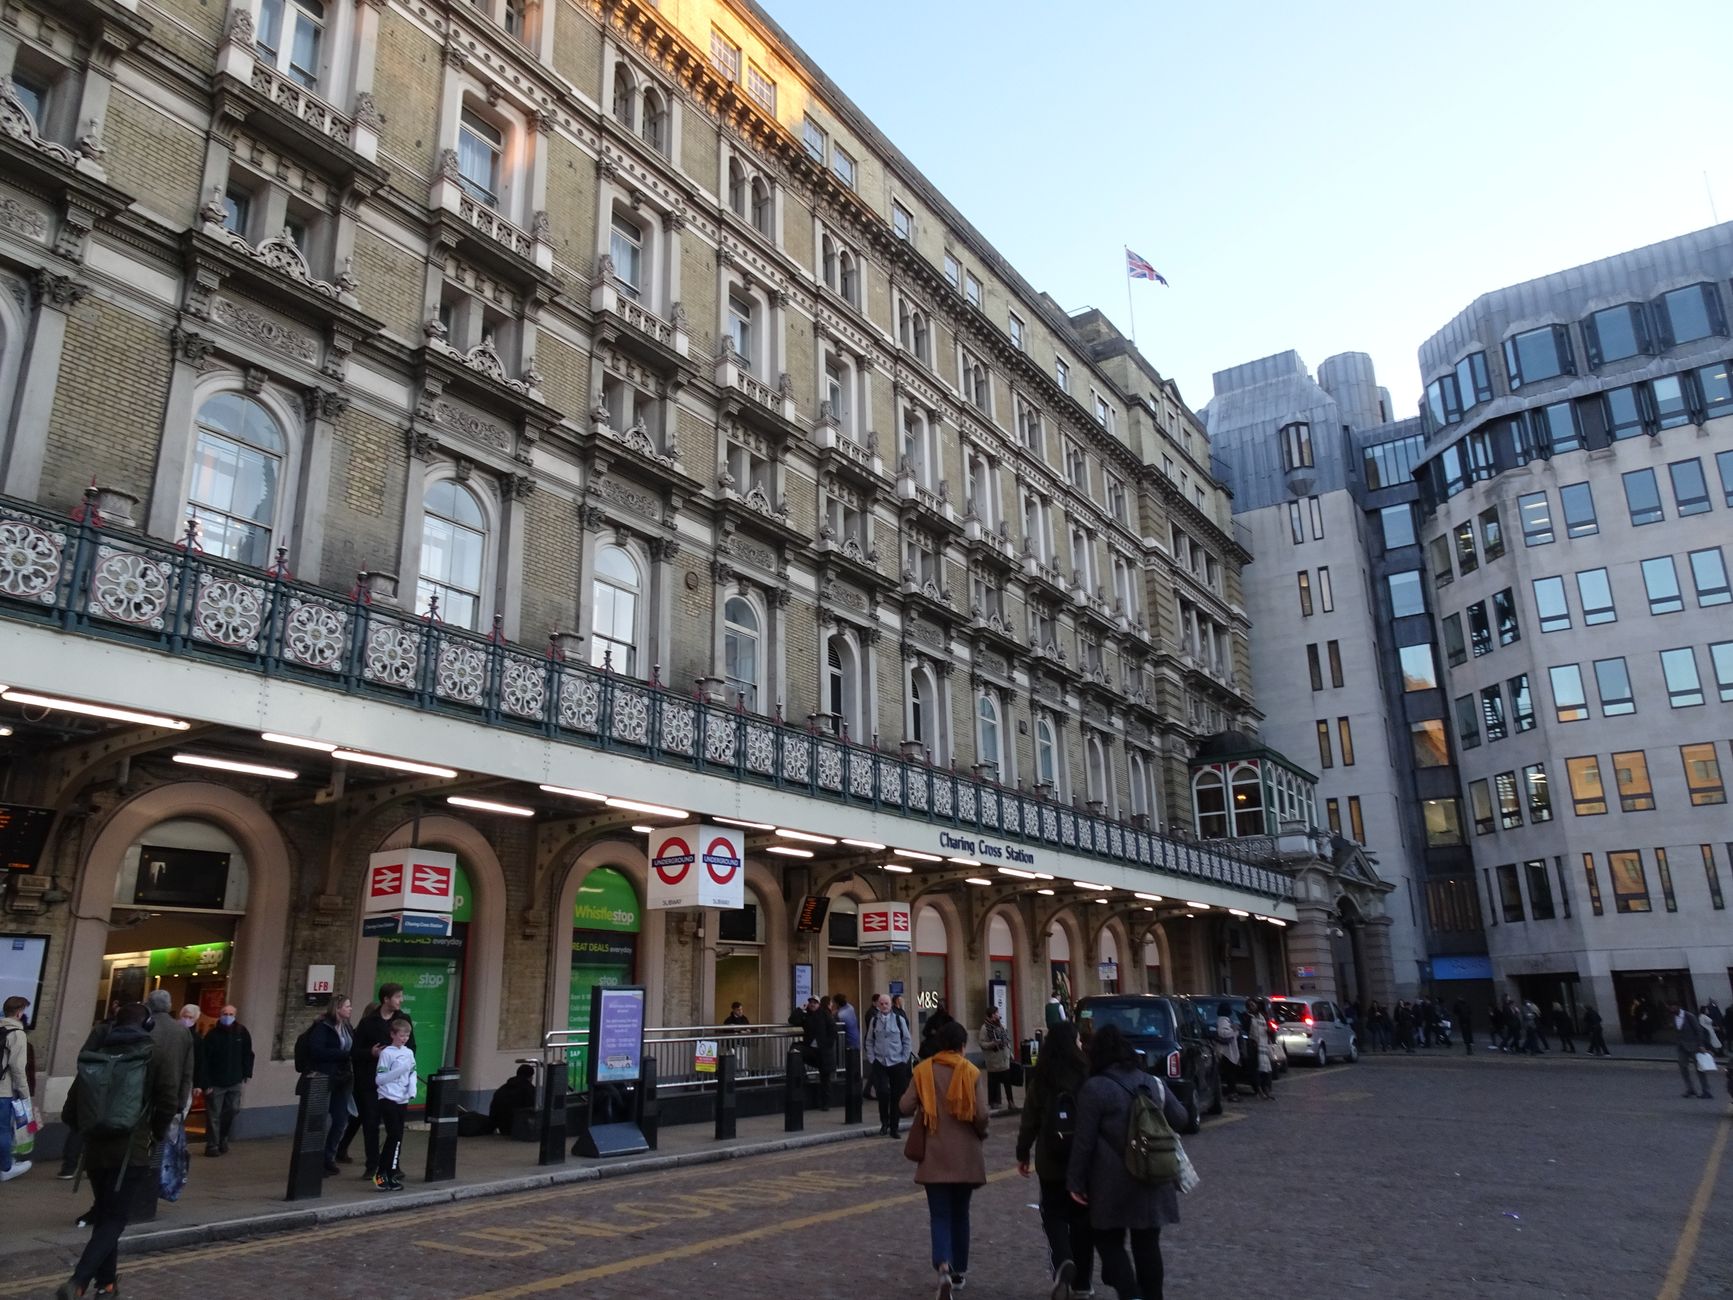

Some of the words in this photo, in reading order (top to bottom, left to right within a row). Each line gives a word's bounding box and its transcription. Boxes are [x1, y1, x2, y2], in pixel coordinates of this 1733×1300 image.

[939, 831, 975, 856] Charing
[978, 839, 1003, 858] Cross
[1005, 845, 1034, 864] Station
[653, 856, 694, 866] UNDERGROUND
[703, 855, 739, 866] UNDERGROUND
[575, 904, 635, 924] Whistlestop
[572, 942, 587, 951] REAT
[589, 943, 609, 952] DEALS
[313, 981, 329, 991] LFB
[917, 991, 939, 1009] M&S
